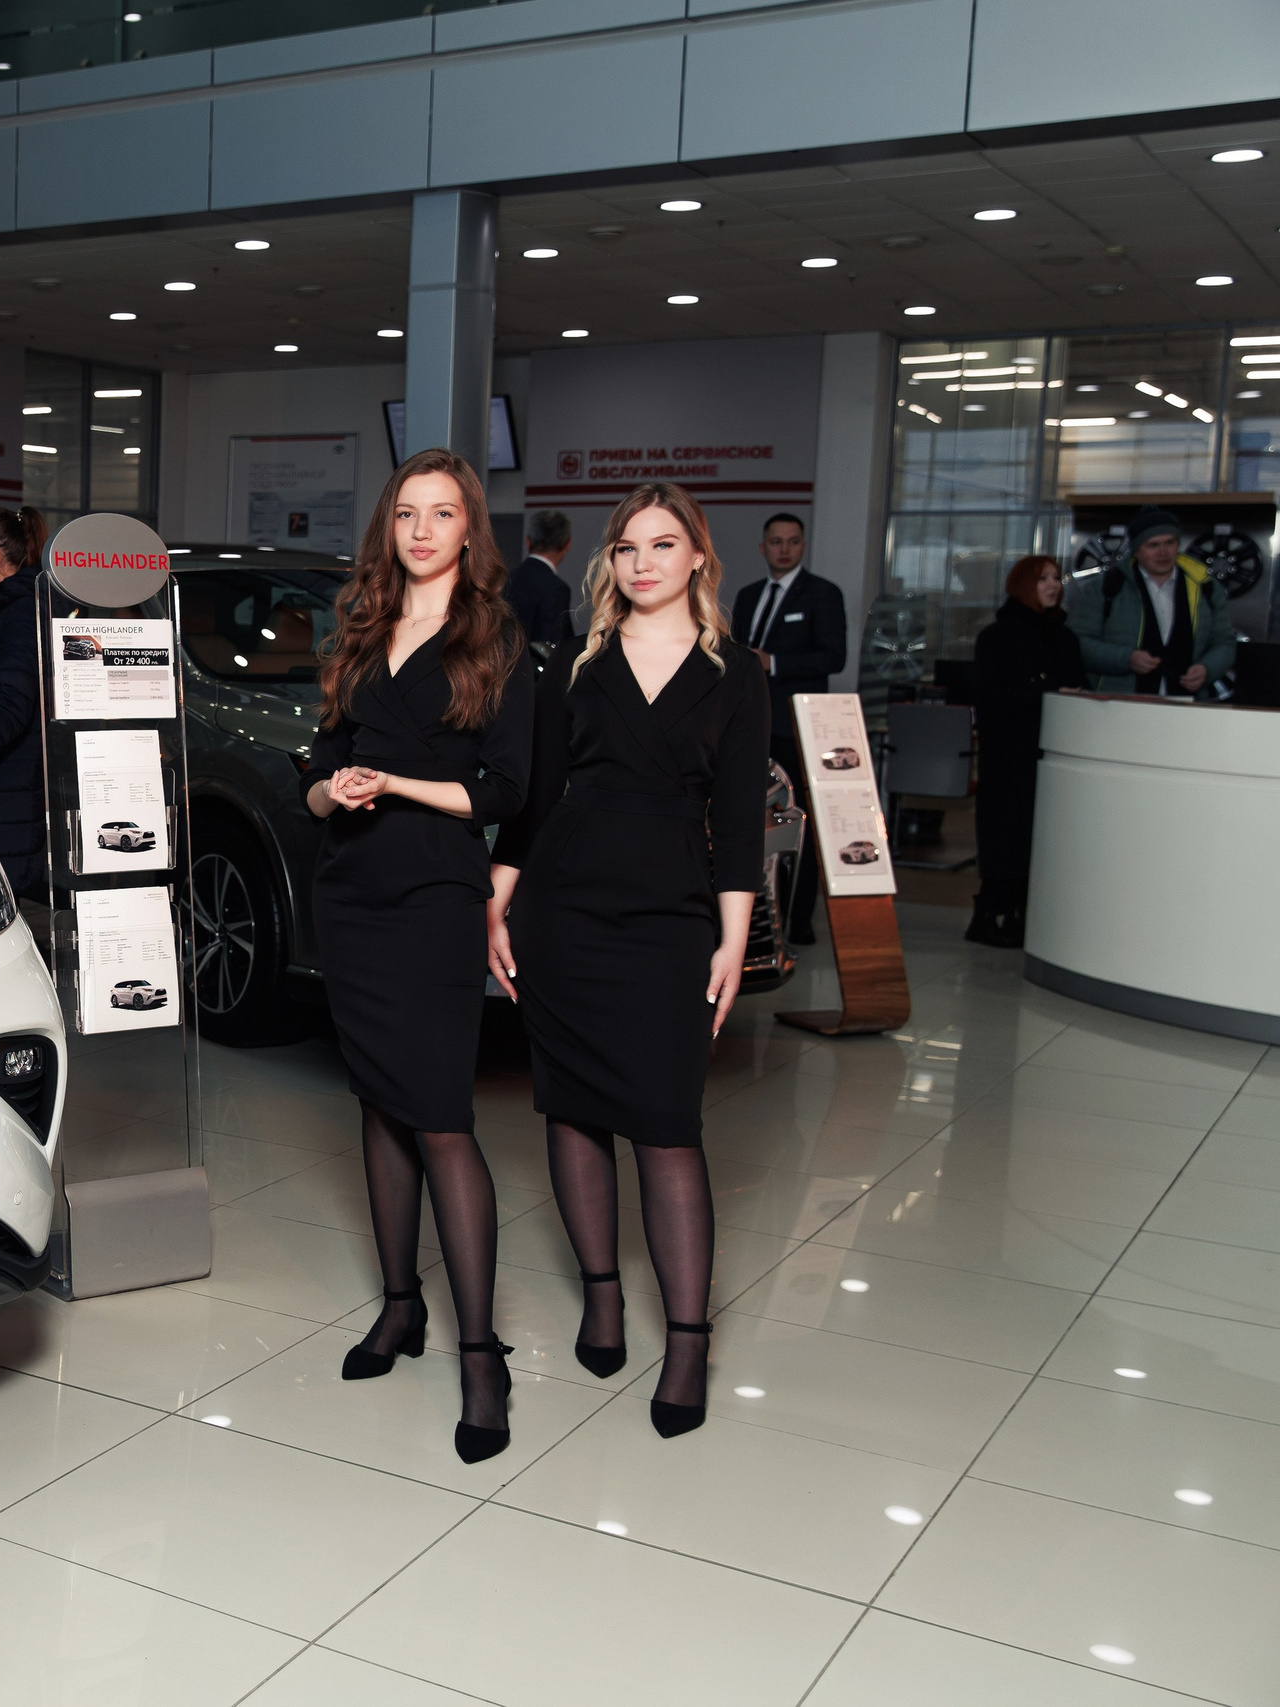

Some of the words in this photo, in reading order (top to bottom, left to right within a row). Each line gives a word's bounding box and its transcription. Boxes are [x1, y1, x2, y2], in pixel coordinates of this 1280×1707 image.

[588, 448, 642, 462] ПРИЕМ
[647, 447, 667, 461] НА
[672, 445, 774, 460] СЕРВИСНОЕ
[588, 464, 718, 480] ОБСЛУЖИВАНИЕ
[54, 551, 169, 570] HIGHLANDER
[60, 626, 91, 634] TOYOTA
[93, 626, 144, 634] HIGHLANDER
[141, 650, 169, 658] кредиту
[113, 657, 124, 665] От
[125, 657, 135, 665] 29
[137, 657, 151, 665] 400
